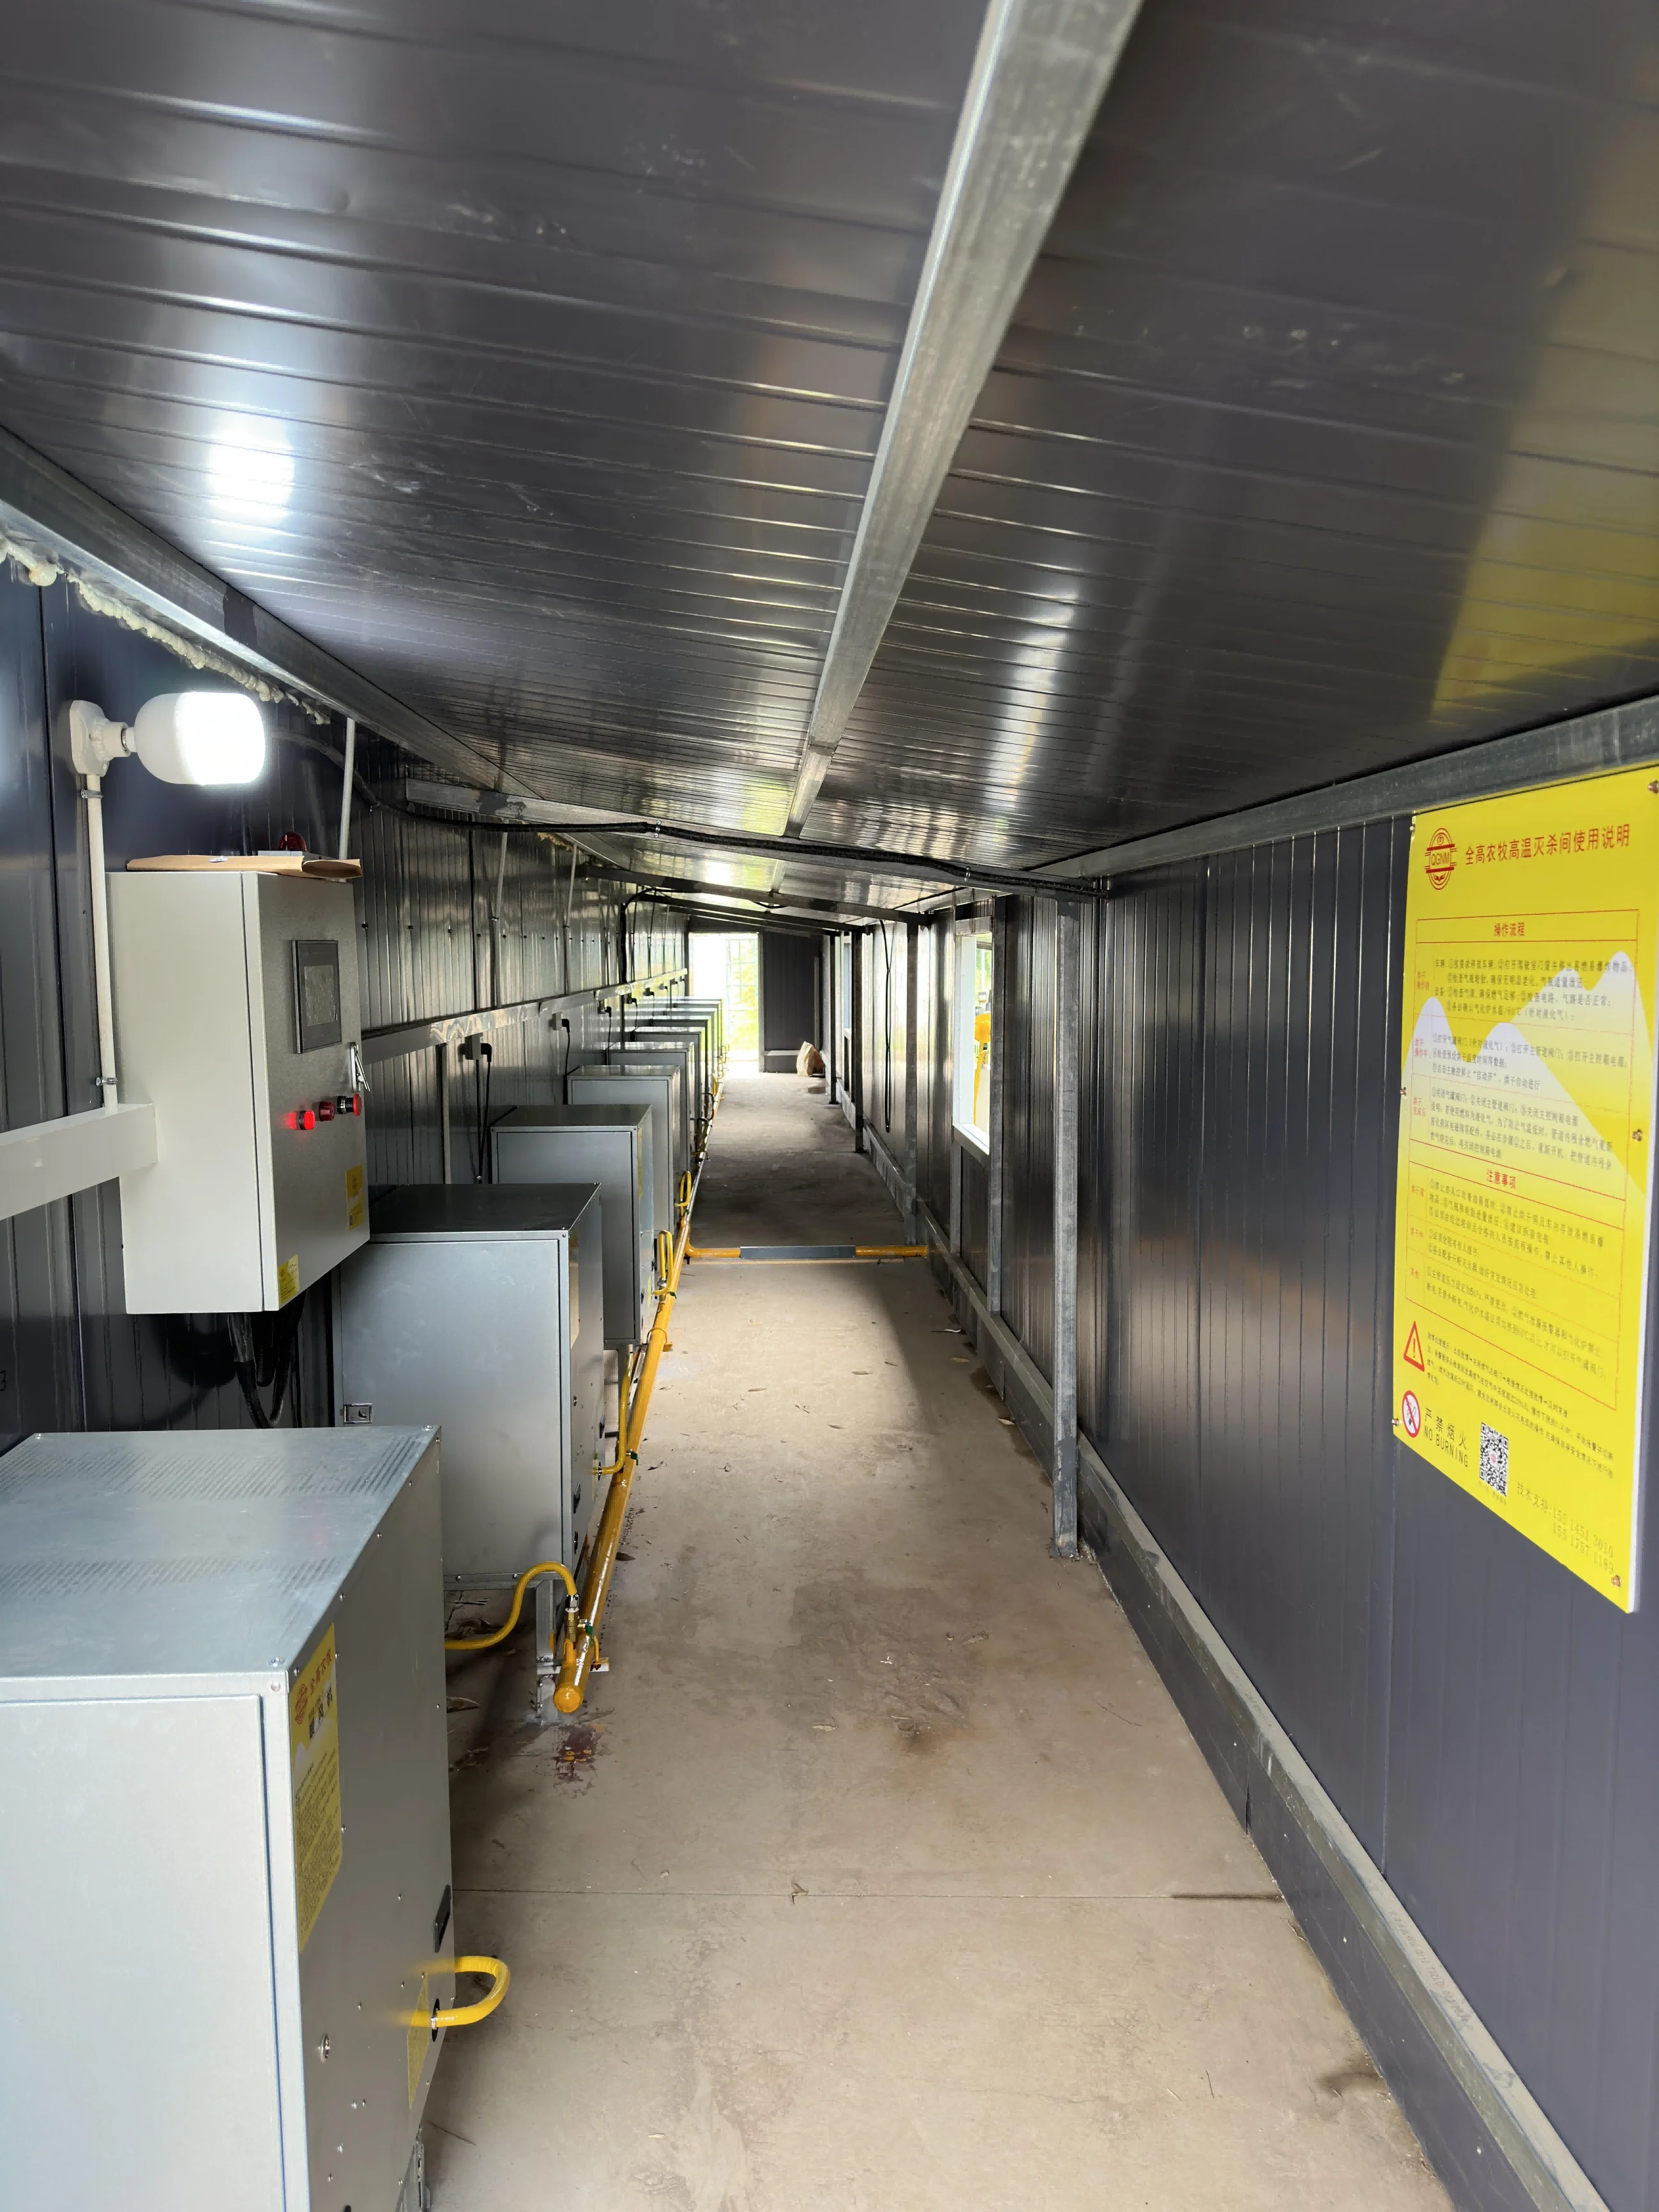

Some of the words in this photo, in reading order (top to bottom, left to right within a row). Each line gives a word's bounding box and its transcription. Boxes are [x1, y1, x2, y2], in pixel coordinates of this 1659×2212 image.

[1430, 850, 1450, 866] QGNM
[1465, 823, 1630, 865] 全高农牧高温灭杀间使用说明
[1486, 1169, 1517, 1190] 注意事项
[1423, 1425, 1434, 1443] NO
[1436, 1433, 1469, 1468] BURNING
[1425, 1407, 1467, 1450] 严禁烟火
